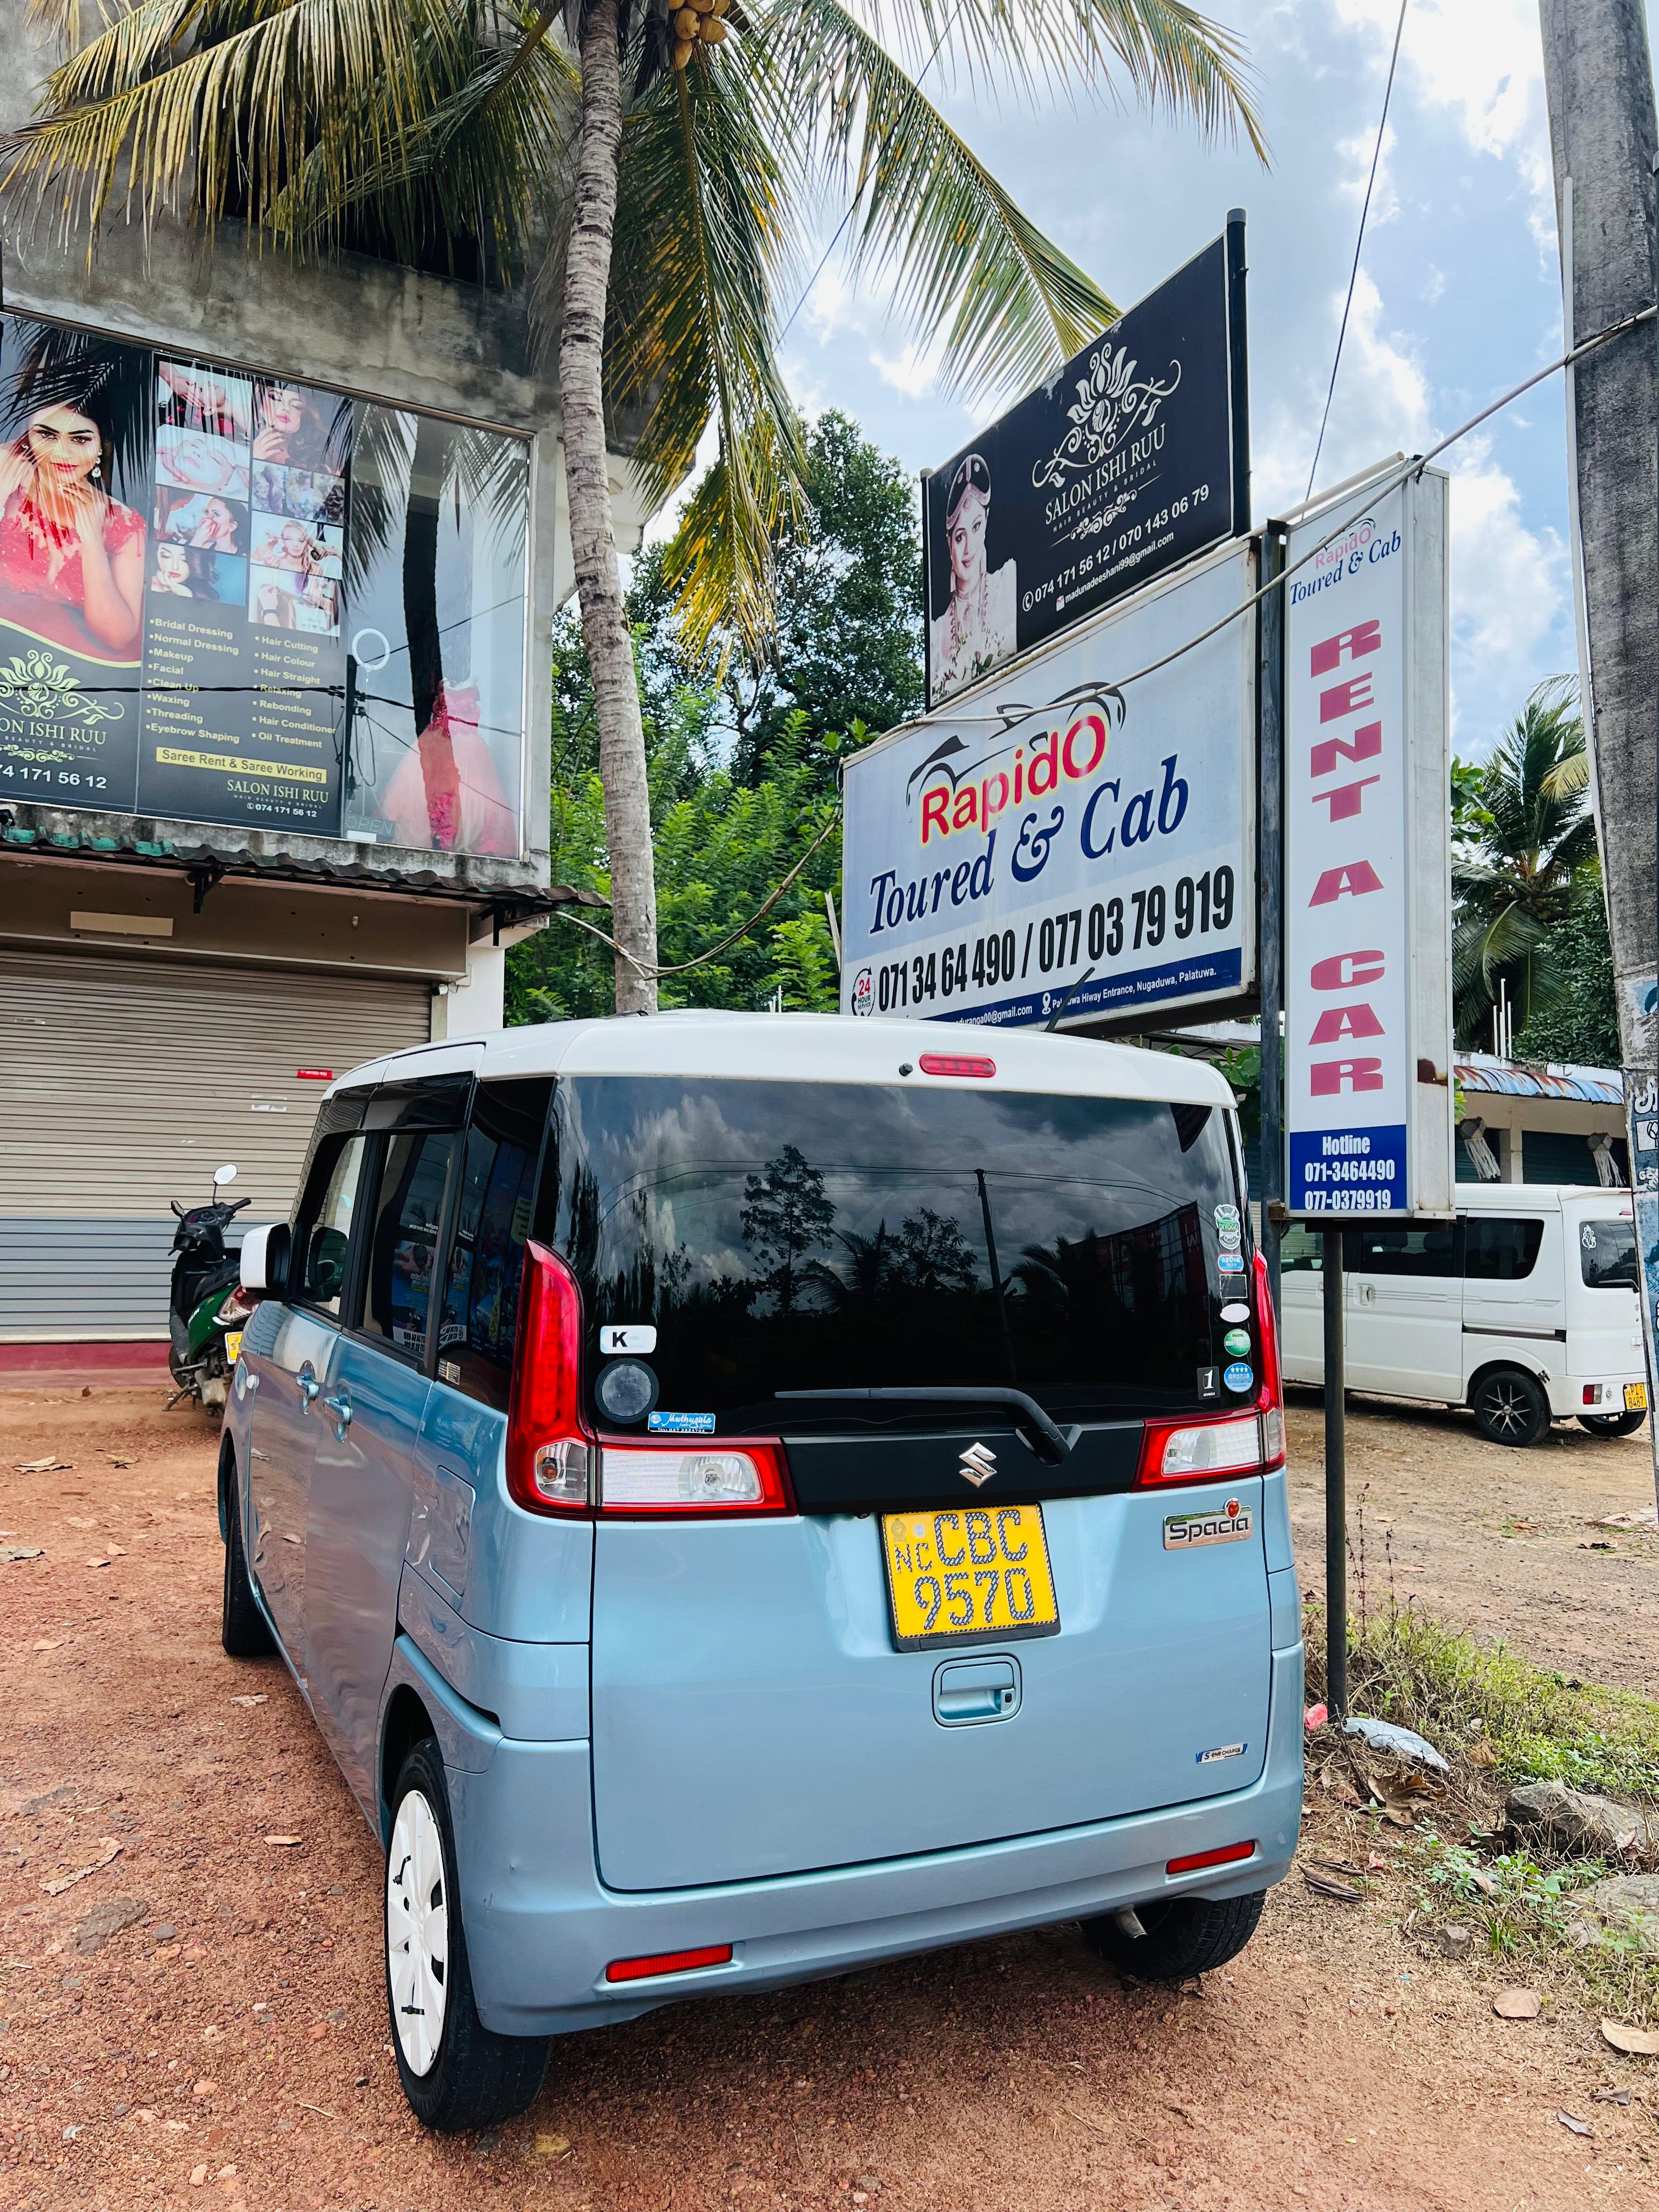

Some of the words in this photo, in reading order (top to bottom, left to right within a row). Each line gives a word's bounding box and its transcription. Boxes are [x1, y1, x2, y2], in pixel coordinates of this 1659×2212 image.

[1046, 473, 1093, 524] SALON
[1096, 449, 1126, 491] ISHI
[1130, 423, 1166, 467] RUU
[1053, 516, 1071, 533] HAIR
[1076, 491, 1108, 517] BEAUTY
[1124, 459, 1156, 486] BRIDAL
[1035, 579, 1054, 602] 074
[1057, 566, 1075, 588] 171
[1079, 555, 1093, 575] 56
[1096, 544, 1110, 564] 12
[1119, 525, 1142, 550] 070
[1145, 509, 1169, 534] 143
[1171, 496, 1188, 518] 06
[1192, 484, 1209, 506] 79
[1289, 558, 1344, 606] Toured
[1348, 551, 1363, 574] &
[1369, 529, 1402, 564] Cab
[155, 618, 185, 630] Bridal
[188, 623, 233, 640] Dressing
[154, 633, 191, 646] Normal
[194, 639, 239, 656] Dressing
[262, 636, 281, 646] Hair
[284, 640, 318, 654] Cutting
[154, 648, 194, 663] Makeup
[261, 652, 281, 662] Hair
[283, 656, 315, 668] Colour
[153, 663, 184, 675] Facial
[261, 668, 281, 679] Hair
[283, 671, 320, 685] Straight
[153, 678, 182, 689] Clean
[185, 682, 199, 693] Up
[260, 684, 302, 699] Relaxing
[151, 692, 190, 708] Waxing
[259, 699, 312, 716] Rebonding
[151, 707, 203, 724] Threading
[259, 716, 279, 726] Hair
[281, 719, 337, 734] Conditioner
[1311, 619, 1382, 823] RENT
[4, 735, 43, 745] BEAUTY
[61, 743, 97, 752] BRIDAL
[30, 721, 65, 739] ISHI
[70, 727, 107, 745] RUU
[150, 723, 196, 737] Eyebrow
[198, 730, 240, 744] Shaping
[258, 732, 272, 741] Oil
[274, 734, 323, 748] Treatment
[162, 749, 195, 763] Saree
[199, 754, 226, 767] Rent
[229, 759, 238, 768] &
[241, 760, 273, 773] Saree
[276, 764, 323, 782] Working
[0, 764, 14, 777] 4
[20, 767, 52, 782] 171
[58, 771, 81, 785] 56
[85, 775, 107, 789] 12
[227, 779, 270, 795] SALON
[273, 785, 299, 799] ISHI
[302, 789, 329, 803] RUU
[255, 803, 273, 812] 074
[274, 806, 290, 814] 171
[870, 828, 997, 935] Toured
[1011, 805, 1064, 882] &
[1080, 753, 1188, 859] Cab
[1308, 860, 1385, 908] A
[879, 961, 907, 1012] 071
[912, 952, 936, 1004] 34
[941, 943, 967, 997] 64
[972, 929, 1015, 988] 490
[1021, 923, 1034, 979] /
[1039, 909, 1082, 973] 077
[1088, 897, 1124, 961] 03
[1131, 885, 1166, 950] 79
[1175, 865, 1234, 939] 919
[859, 977, 871, 996] 24
[1052, 996, 1080, 1009] Paluwa
[1082, 992, 1102, 1003] Hiway
[1103, 983, 1135, 998] Entrance,
[1136, 975, 1177, 992] Nugaduwa,
[1179, 967, 1217, 983] Palatuwa.
[857, 995, 871, 1005] HOUR
[1308, 950, 1386, 1097] CAR
[1322, 1135, 1370, 1156] Hotline
[1305, 1159, 1396, 1182] 071-3464490
[1305, 1189, 1392, 1210] 077-0379919
[612, 1331, 628, 1347] K
[934, 1510, 1028, 1566] CBC
[1170, 1517, 1249, 1543] Spacia
[894, 1543, 933, 1573] NC
[914, 1567, 1035, 1630] 9570
[1222, 1747, 1241, 1756] CHARGE
